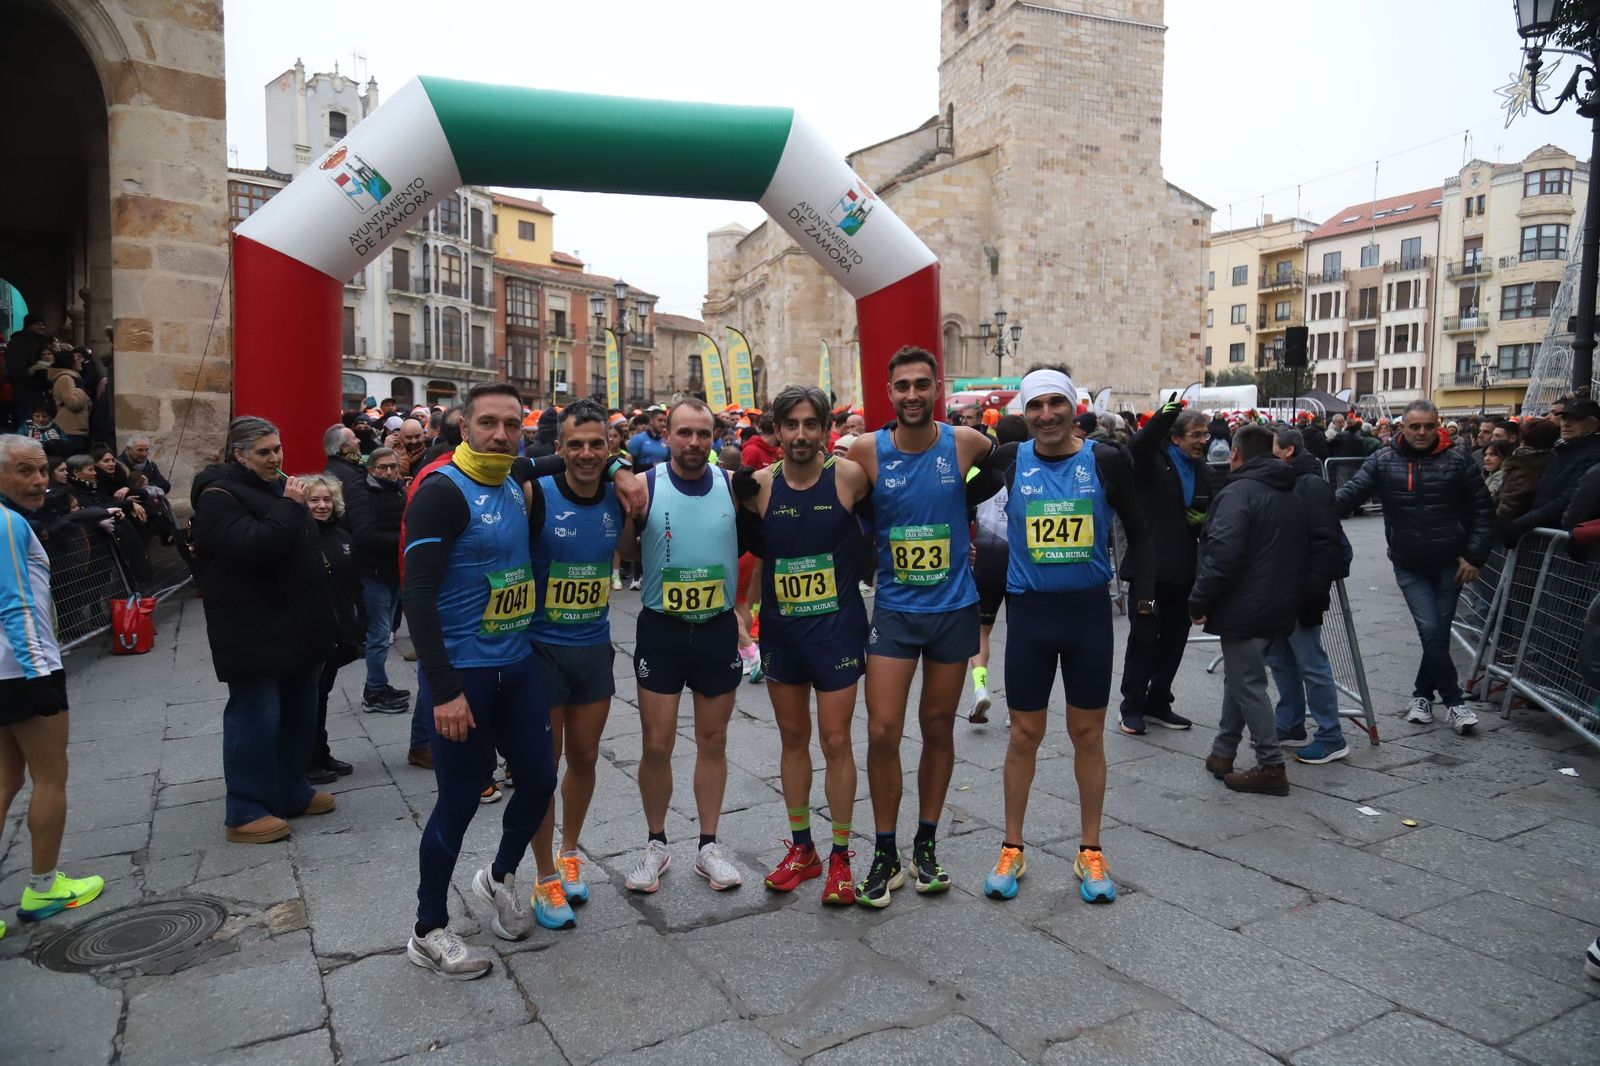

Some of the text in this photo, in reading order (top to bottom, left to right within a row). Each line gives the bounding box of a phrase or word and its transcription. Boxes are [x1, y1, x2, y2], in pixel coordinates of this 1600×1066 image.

[349, 177, 424, 246] AYUNTAMIENTO
[355, 190, 433, 257] DE ZAMORA
[787, 207, 853, 274] DE ZAMORA
[797, 201, 863, 265] AYUNTAMIENTO
[1031, 518, 1083, 543] 1247
[895, 545, 942, 570] 823
[1045, 551, 1090, 559] CAJA RURAL
[553, 580, 601, 605] 1058
[668, 585, 716, 611] 987
[779, 572, 826, 598] 1073
[495, 584, 528, 615] 1041
[812, 602, 834, 611] RURA
[563, 612, 580, 620] CAJA
